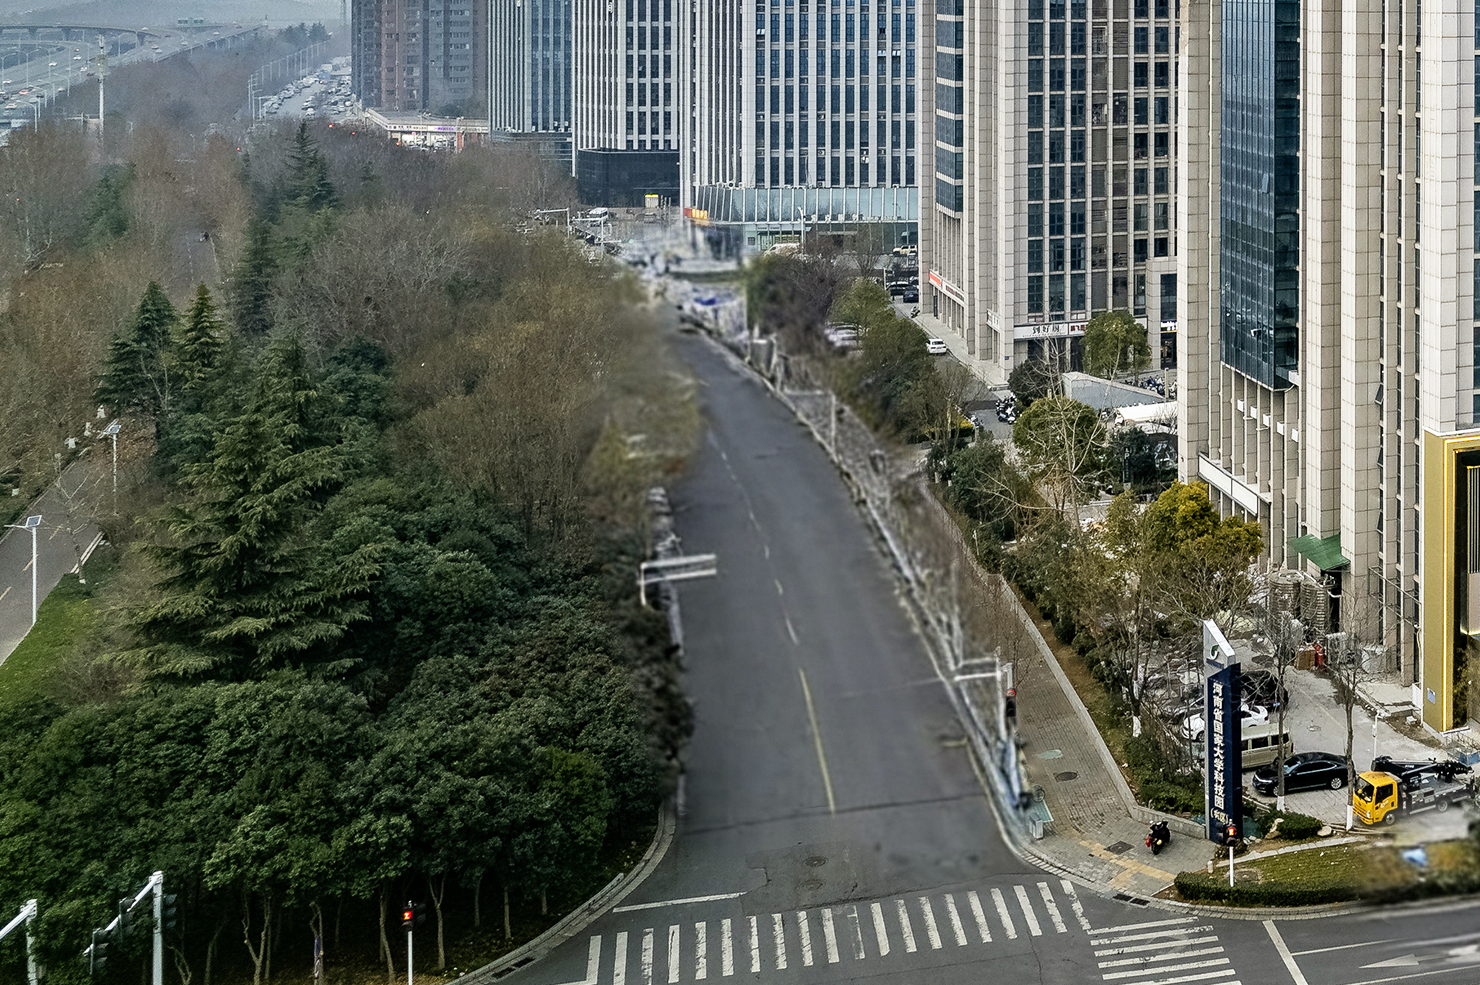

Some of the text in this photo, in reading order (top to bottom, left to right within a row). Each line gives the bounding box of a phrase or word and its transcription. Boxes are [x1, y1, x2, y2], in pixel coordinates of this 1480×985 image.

[1212, 682, 1225, 810] 河南省国家大学科技园
